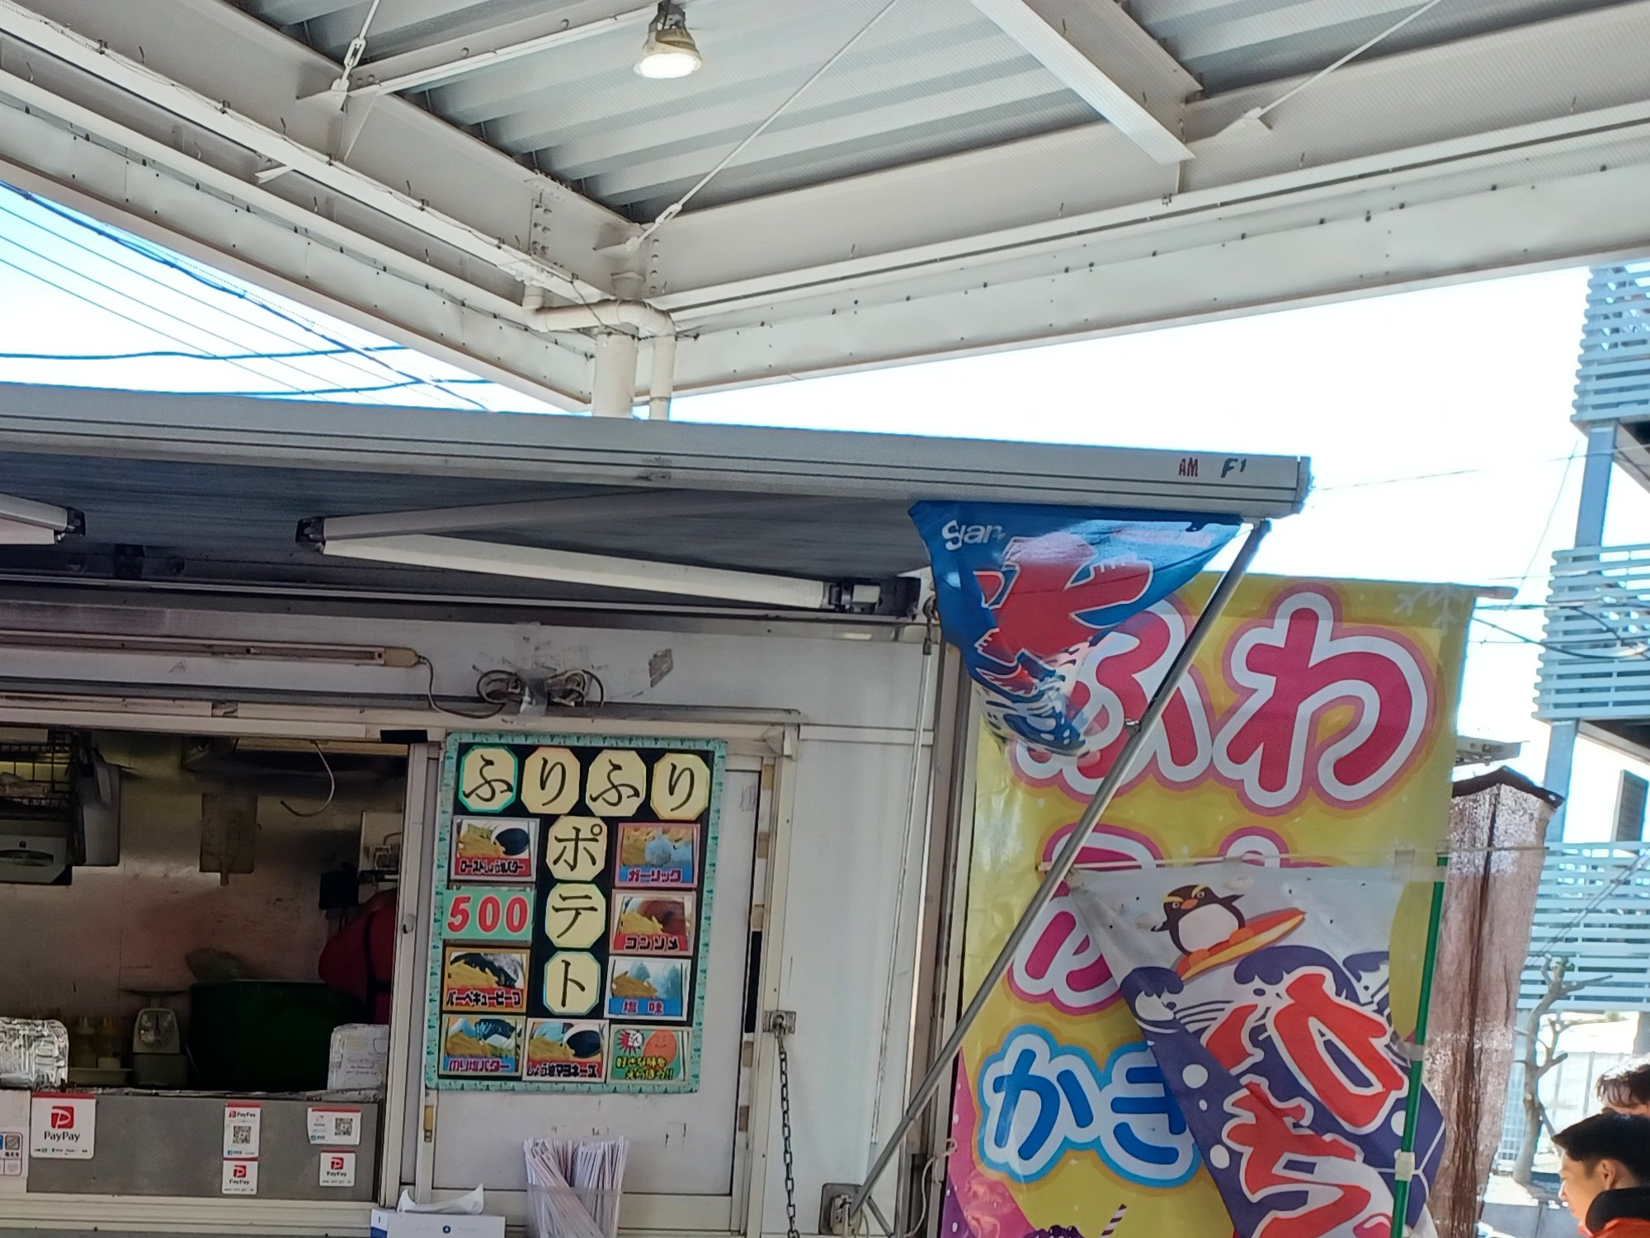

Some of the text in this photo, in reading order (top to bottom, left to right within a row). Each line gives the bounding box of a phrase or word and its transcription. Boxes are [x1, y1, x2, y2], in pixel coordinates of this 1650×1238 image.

[463, 754, 695, 812] ふりふり
[628, 868, 682, 883] ガーリック
[447, 896, 528, 934] 500
[551, 822, 602, 1008] ポテト
[625, 936, 679, 950] コンソメ
[43, 1130, 81, 1143] PayPay
